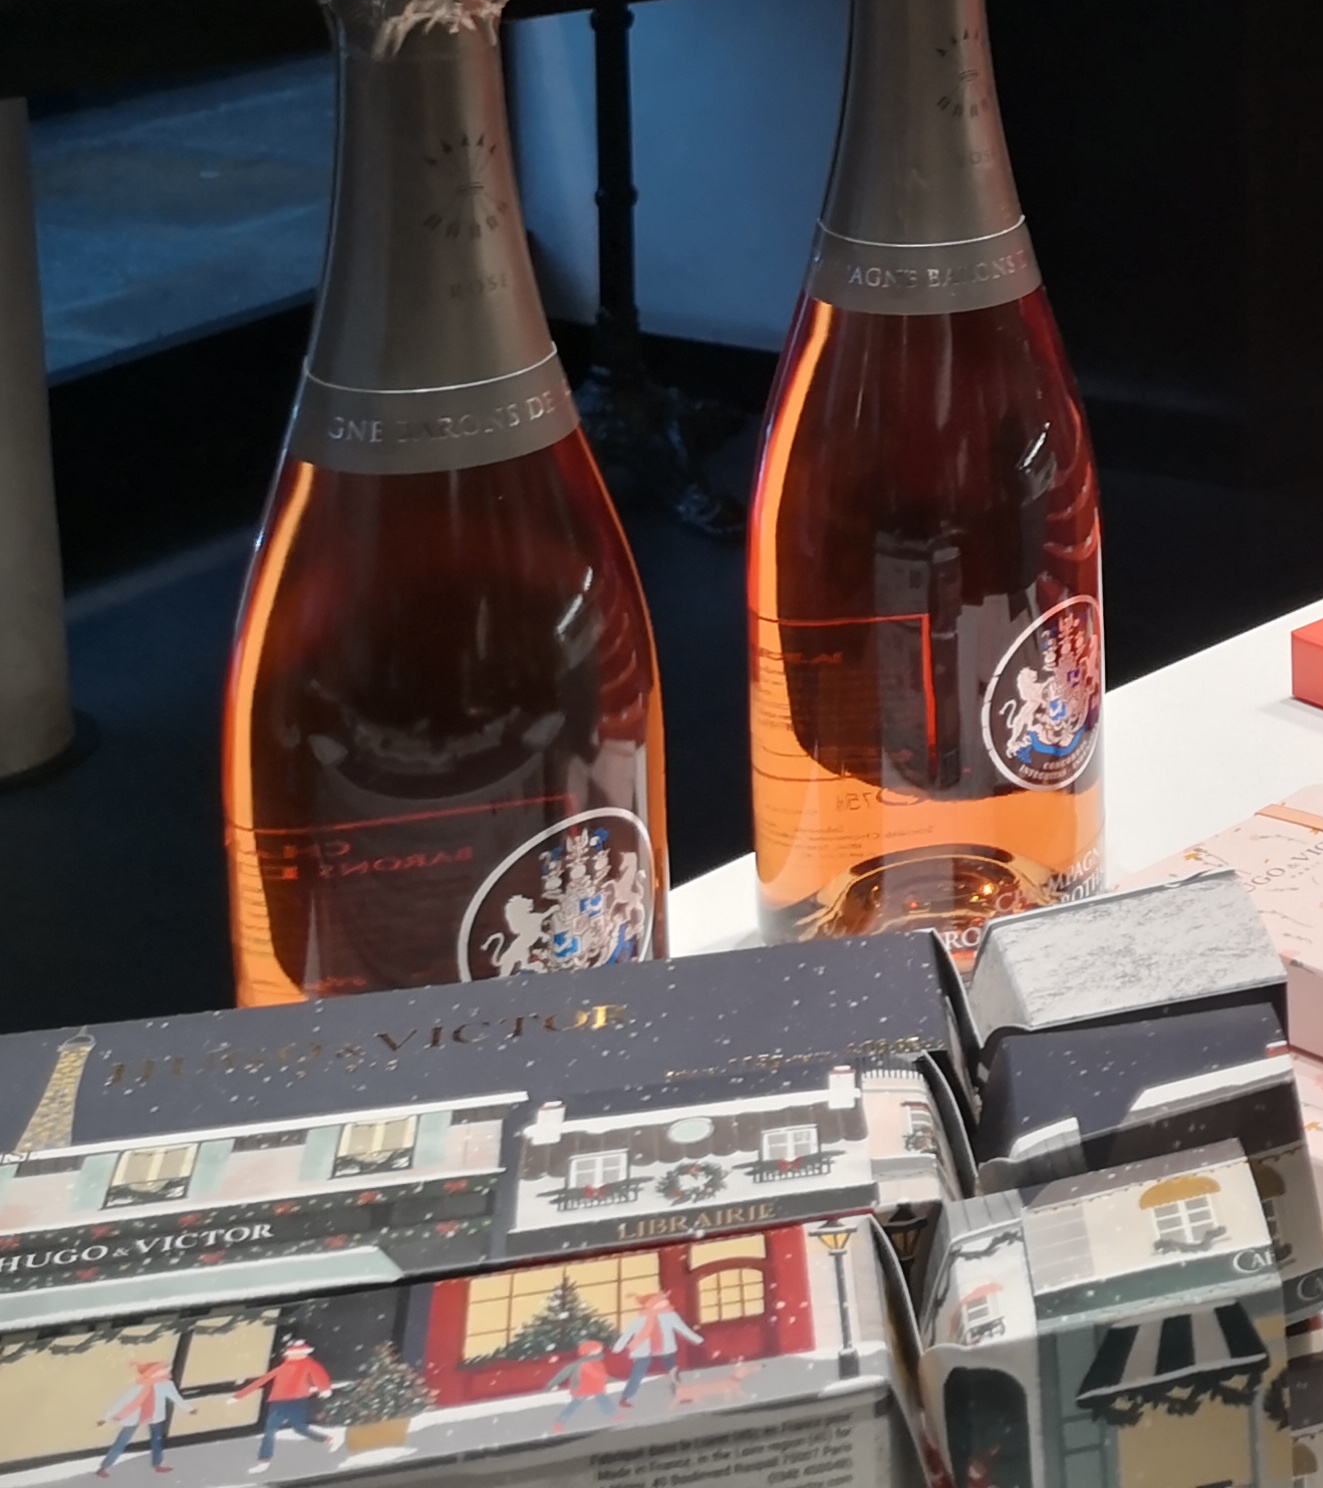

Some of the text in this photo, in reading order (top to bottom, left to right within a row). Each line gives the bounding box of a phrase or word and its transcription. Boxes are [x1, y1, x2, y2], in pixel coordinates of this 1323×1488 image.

[617, 1201, 777, 1241] LIBRAIRIE
[0, 1245, 109, 1274] HUGO
[134, 1222, 275, 1254] VICTOR
